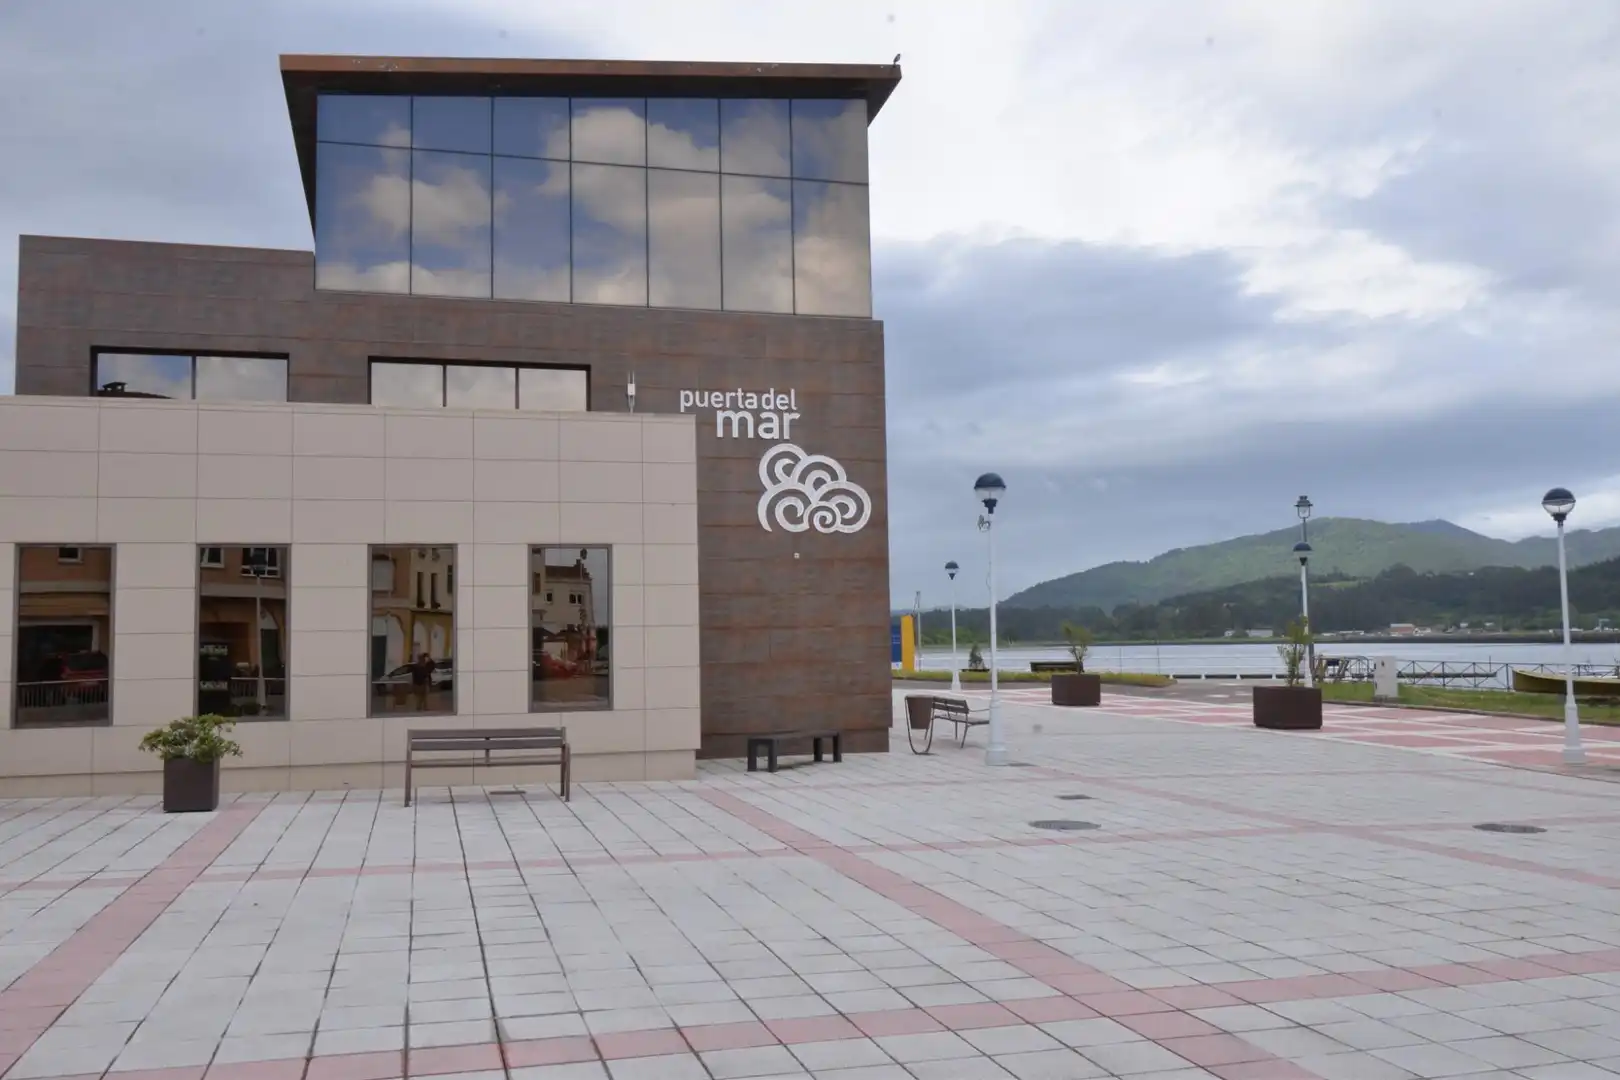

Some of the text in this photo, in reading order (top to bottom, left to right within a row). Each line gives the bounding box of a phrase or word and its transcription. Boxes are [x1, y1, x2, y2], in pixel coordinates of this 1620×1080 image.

[680, 388, 797, 412] puerta del
[716, 410, 800, 440] mar
